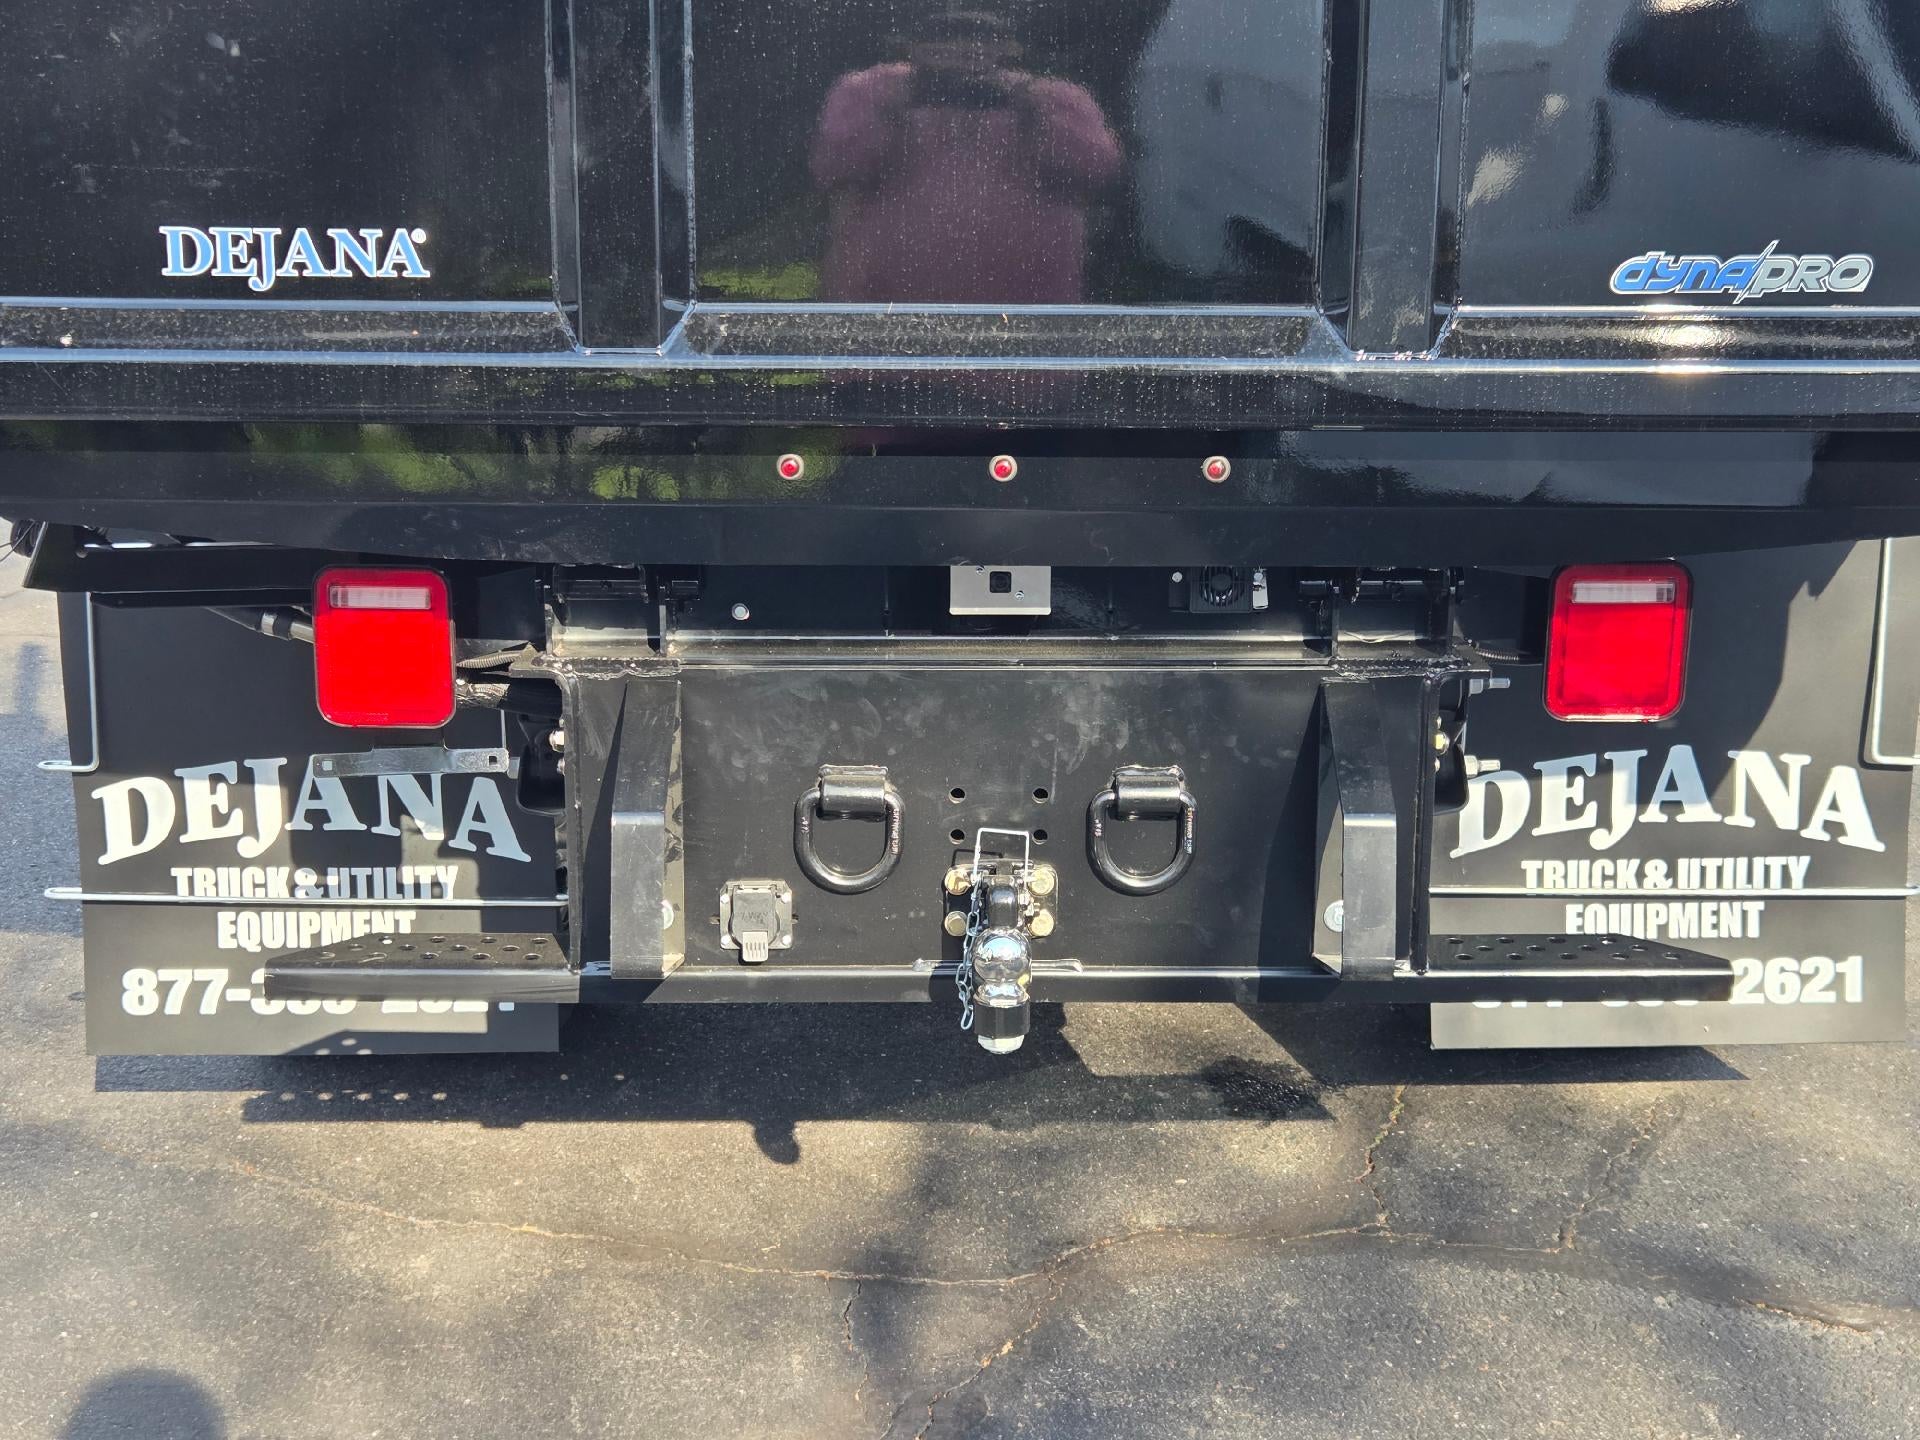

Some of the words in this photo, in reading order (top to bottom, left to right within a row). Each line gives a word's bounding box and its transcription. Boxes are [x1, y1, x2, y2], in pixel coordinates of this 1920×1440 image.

[91, 755, 531, 866] DEJANA
[1449, 744, 1887, 859] DEJANA
[170, 866, 290, 898] TRUCK
[326, 865, 458, 900] UTILITY
[1521, 857, 1642, 889] TRUCK
[1676, 855, 1811, 889] UTILITY
[217, 910, 416, 953] EQUIPMENT
[1565, 900, 1765, 939] EQUIPMENT
